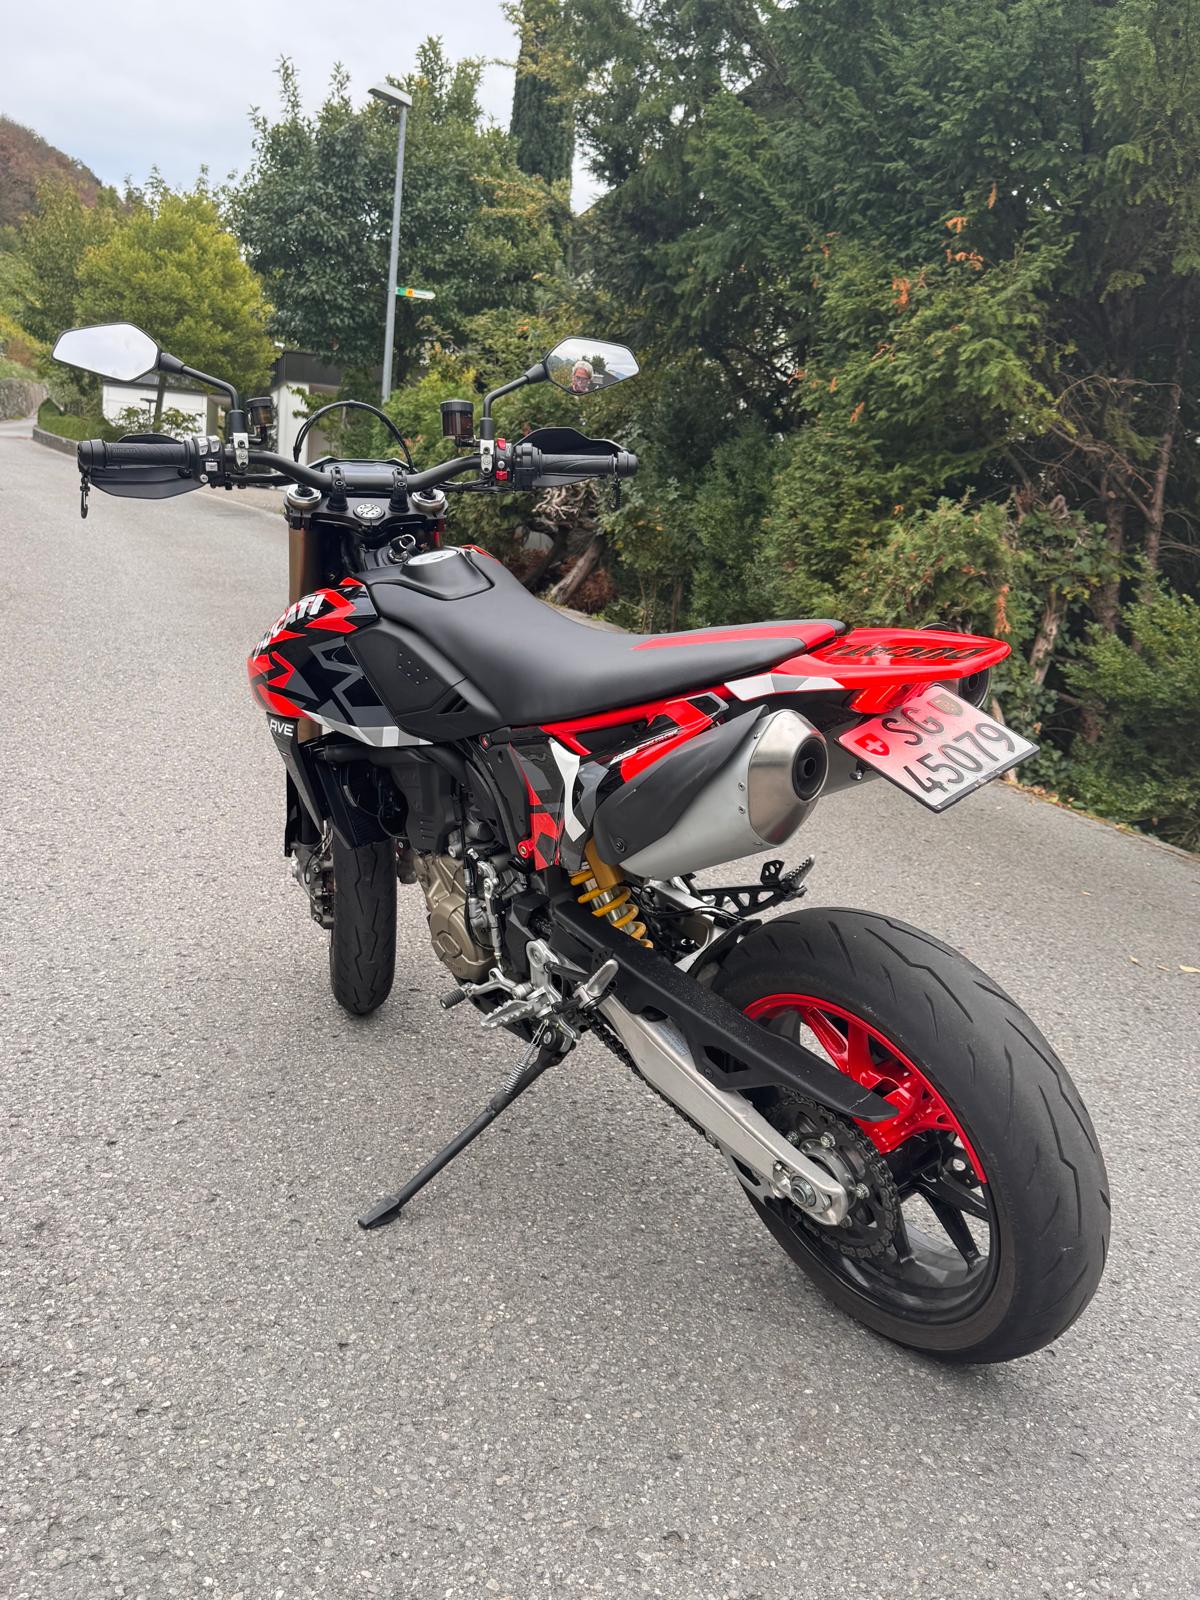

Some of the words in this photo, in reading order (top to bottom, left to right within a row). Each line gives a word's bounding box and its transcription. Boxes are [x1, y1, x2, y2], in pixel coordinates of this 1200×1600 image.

[270, 719, 294, 737] RVE
[881, 707, 945, 746] SG
[903, 723, 1016, 793] 45079
